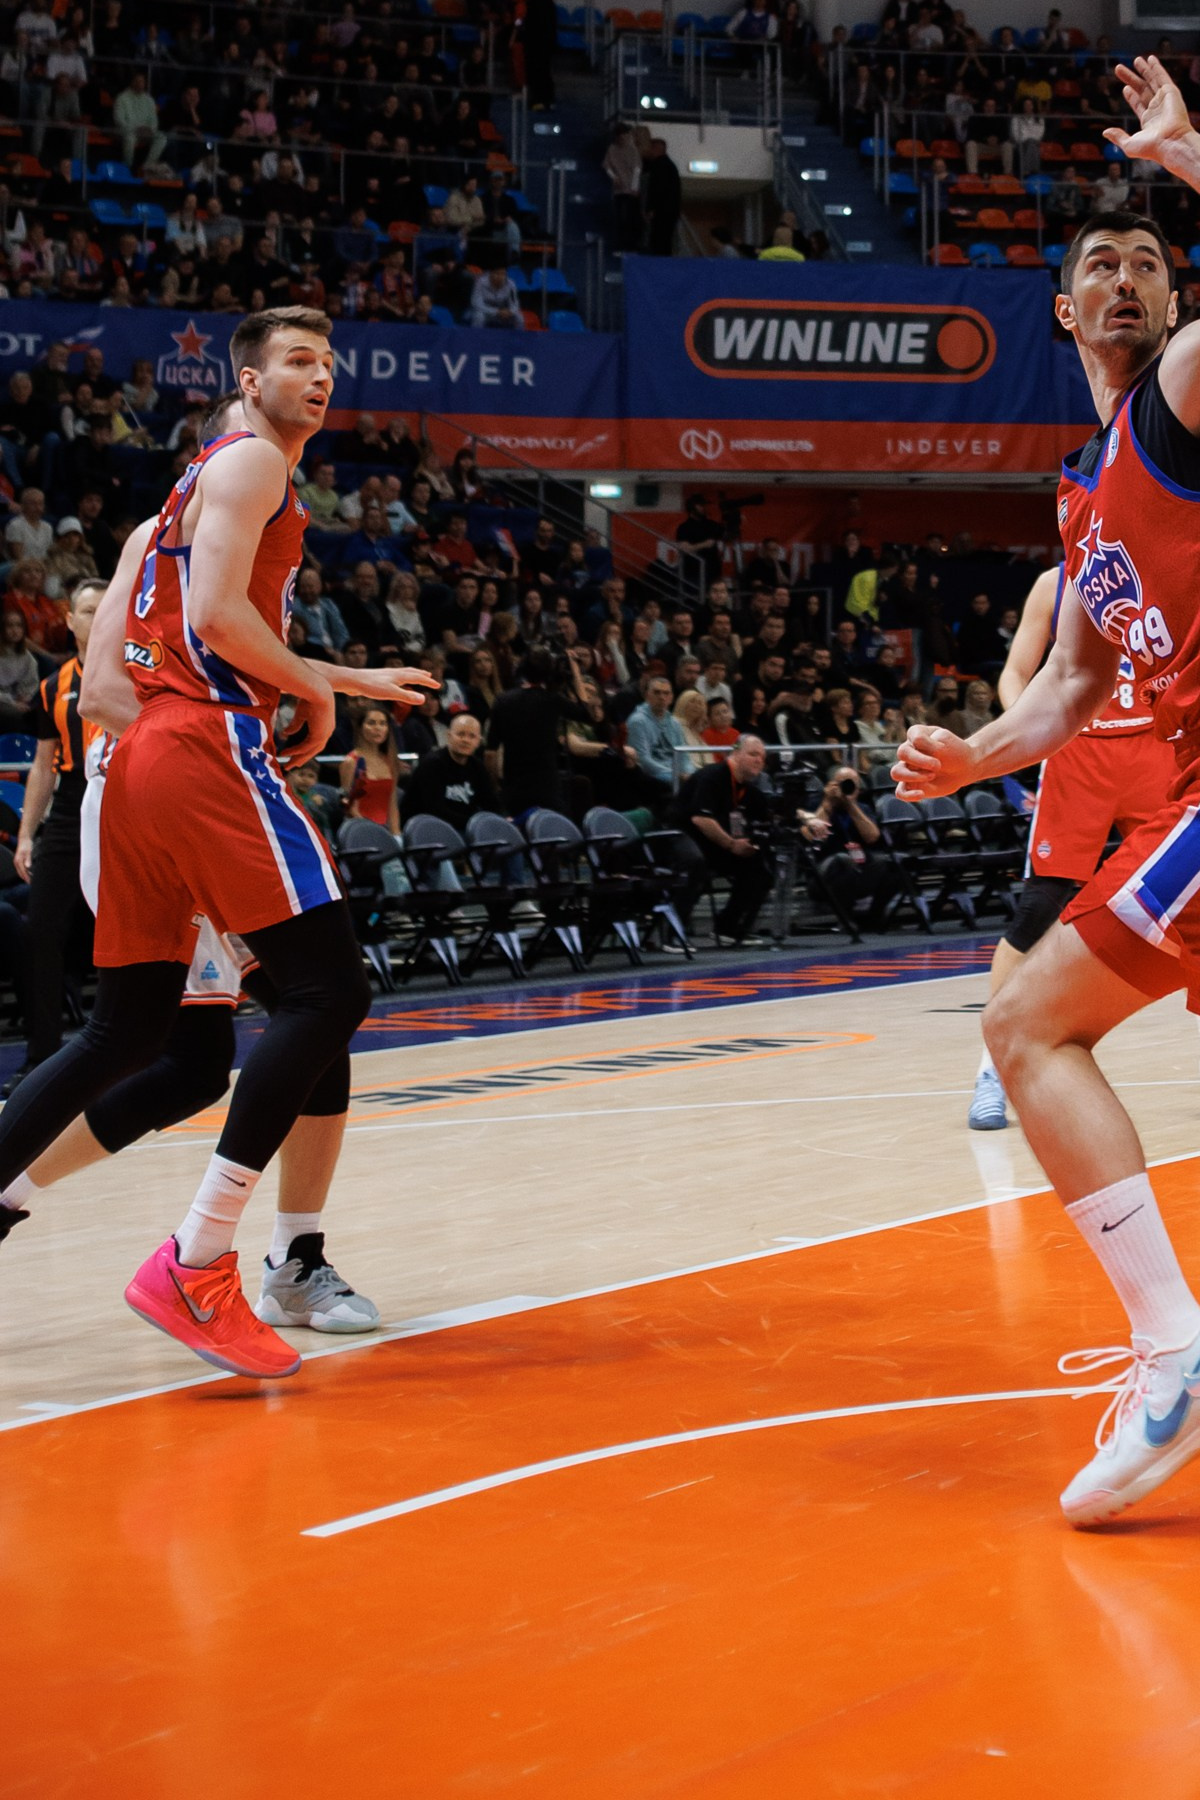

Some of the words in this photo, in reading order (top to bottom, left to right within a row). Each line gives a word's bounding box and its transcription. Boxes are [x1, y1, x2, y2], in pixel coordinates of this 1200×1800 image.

[713, 316, 931, 364] WINLINE
[165, 366, 217, 387] ЦСКА
[333, 351, 536, 387] NDEVER
[886, 437, 1001, 456] INDEVER
[1083, 560, 1131, 610] CSKA
[1128, 605, 1175, 667] 99
[350, 1037, 823, 1106] WINLINE
